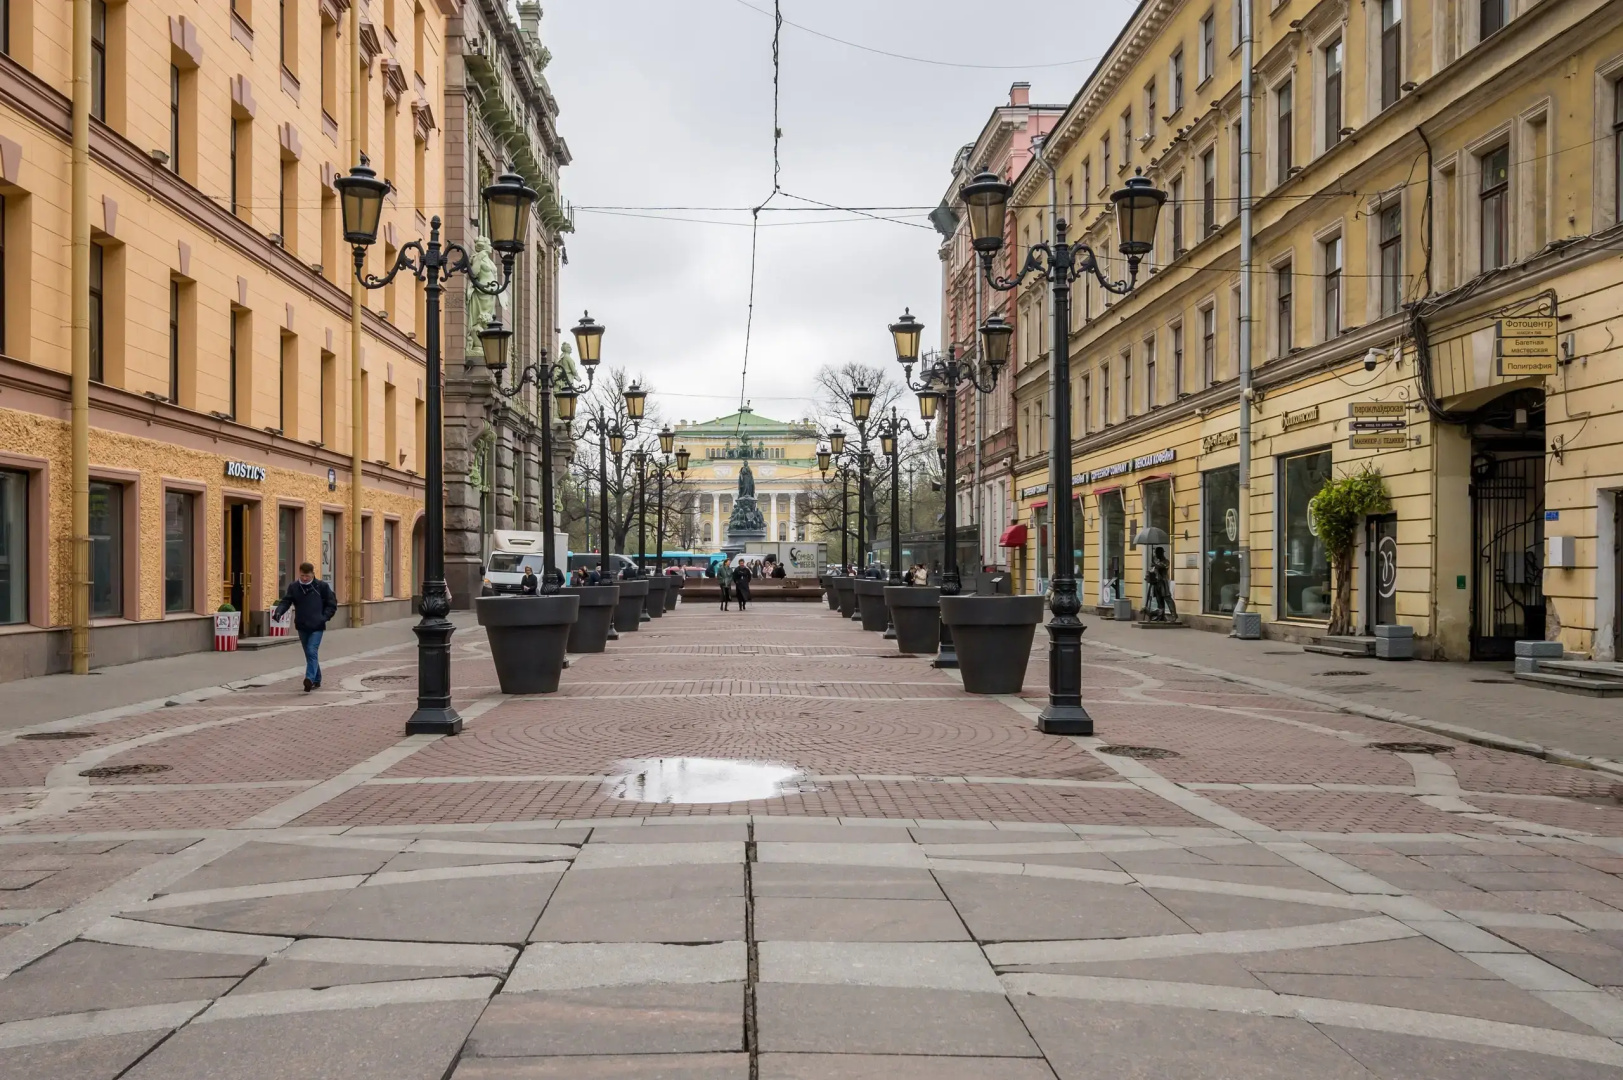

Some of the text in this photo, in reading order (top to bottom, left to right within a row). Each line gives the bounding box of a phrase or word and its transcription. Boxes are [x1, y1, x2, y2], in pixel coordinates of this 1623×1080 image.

[1505, 320, 1553, 328] Фотоцентр
[1354, 437, 1378, 445] МАНИКЮР
[1135, 448, 1174, 470] ВЕНСКАЯ КОФЕЙНЯ
[227, 461, 266, 481] ROSTIC'S
